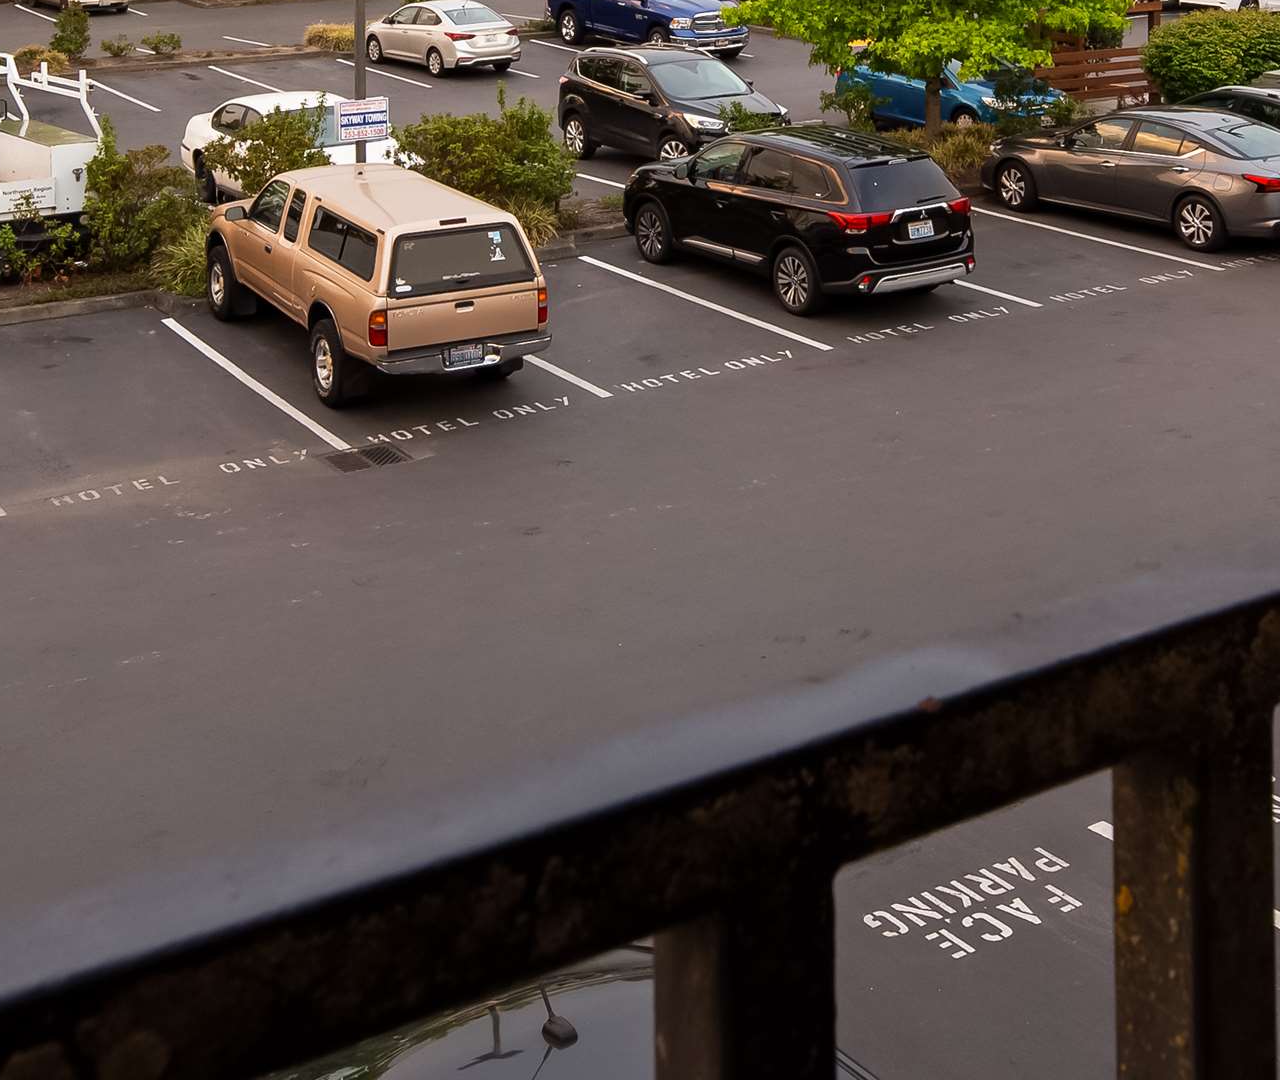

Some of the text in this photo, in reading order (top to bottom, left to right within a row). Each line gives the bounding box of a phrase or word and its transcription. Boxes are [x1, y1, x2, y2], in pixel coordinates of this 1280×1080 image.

[341, 112, 387, 125] SKYWAY TOWING
[344, 128, 385, 138] 253-852-1500
[1049, 269, 1194, 304] HOTEL ONLY
[847, 305, 1010, 344] HOTEL ONLY
[620, 349, 794, 393] HOTEL ONLY
[368, 394, 571, 445] HOTEL ONLY
[50, 448, 309, 507] HOTEL ONLY
[863, 846, 1071, 938] PARKING
[924, 883, 1083, 959] FACE
